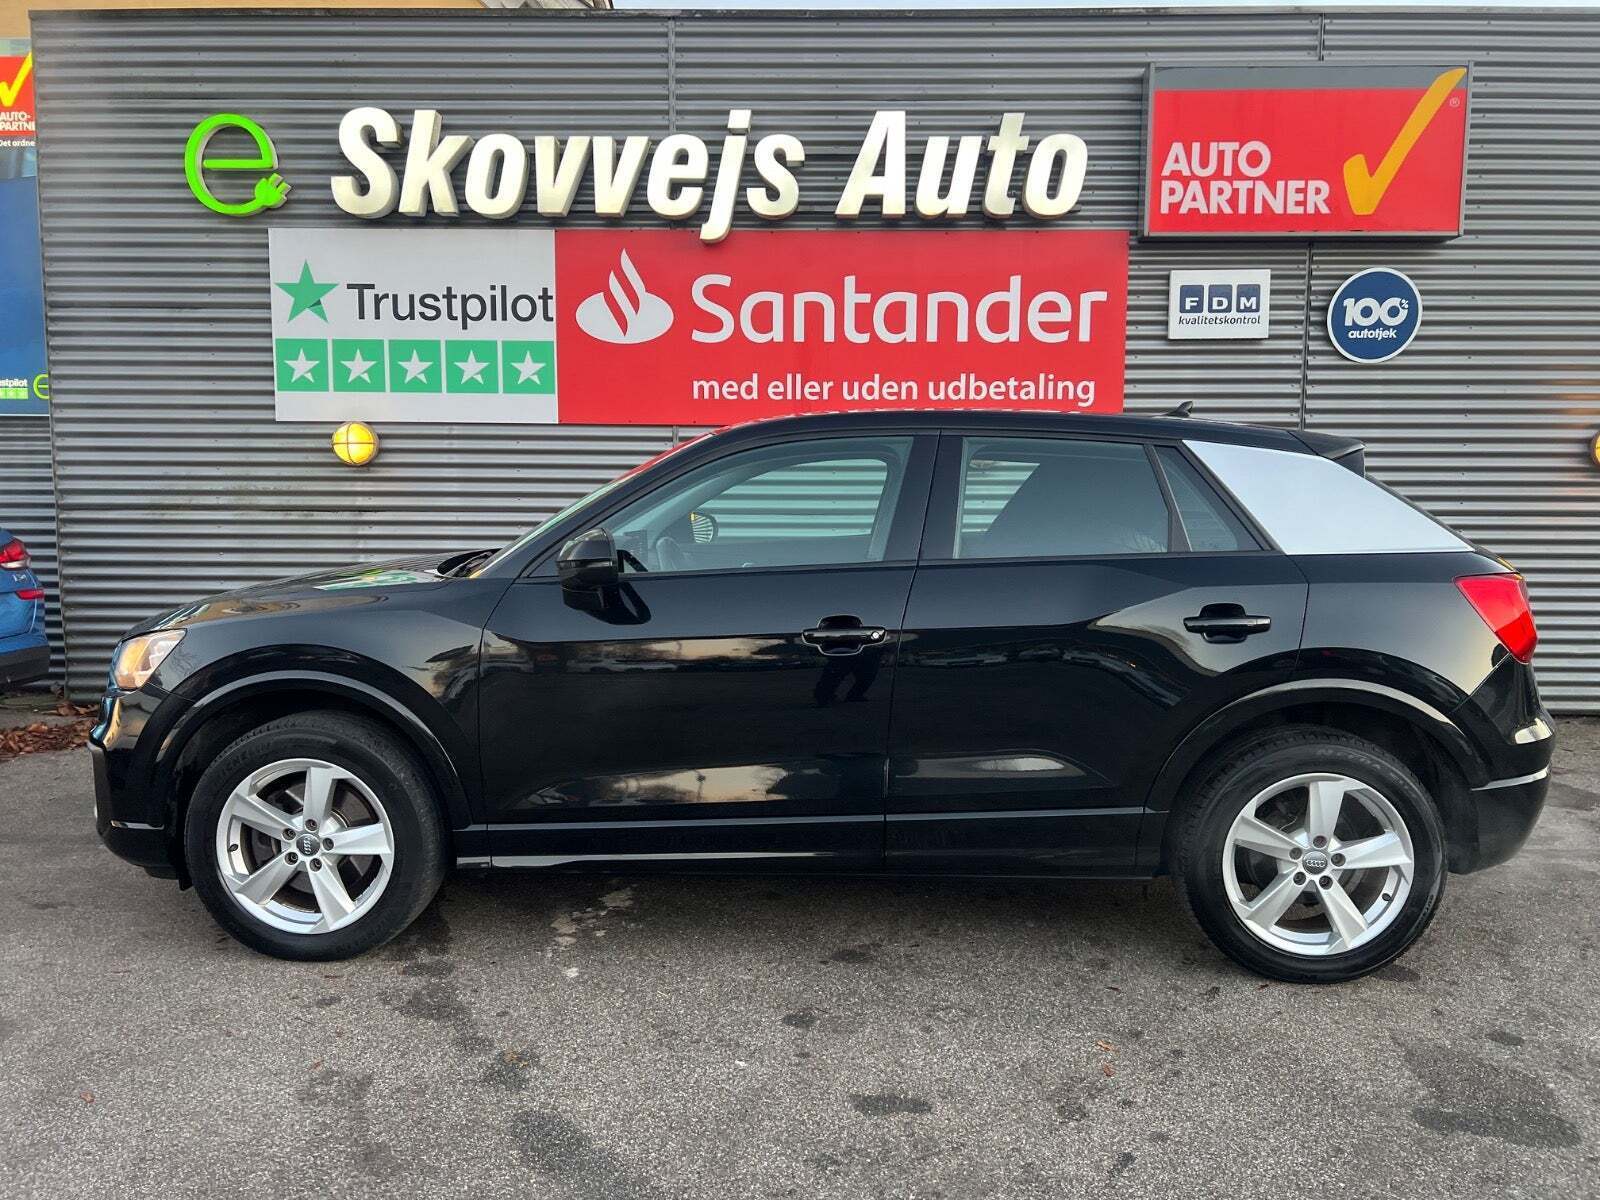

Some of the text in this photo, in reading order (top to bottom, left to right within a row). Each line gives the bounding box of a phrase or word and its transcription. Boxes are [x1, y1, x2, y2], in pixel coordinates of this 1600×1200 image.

[331, 106, 1089, 243] Skovvejs Auto
[1160, 140, 1272, 177] AUTO
[1159, 179, 1332, 215] PARTNER
[346, 283, 554, 330] Trustpilot
[691, 273, 1108, 344] Santander
[1178, 315, 1261, 325] kvalitetskontrol
[1348, 327, 1397, 341] autotjek
[692, 373, 1096, 407] med eller uden udbetaling
